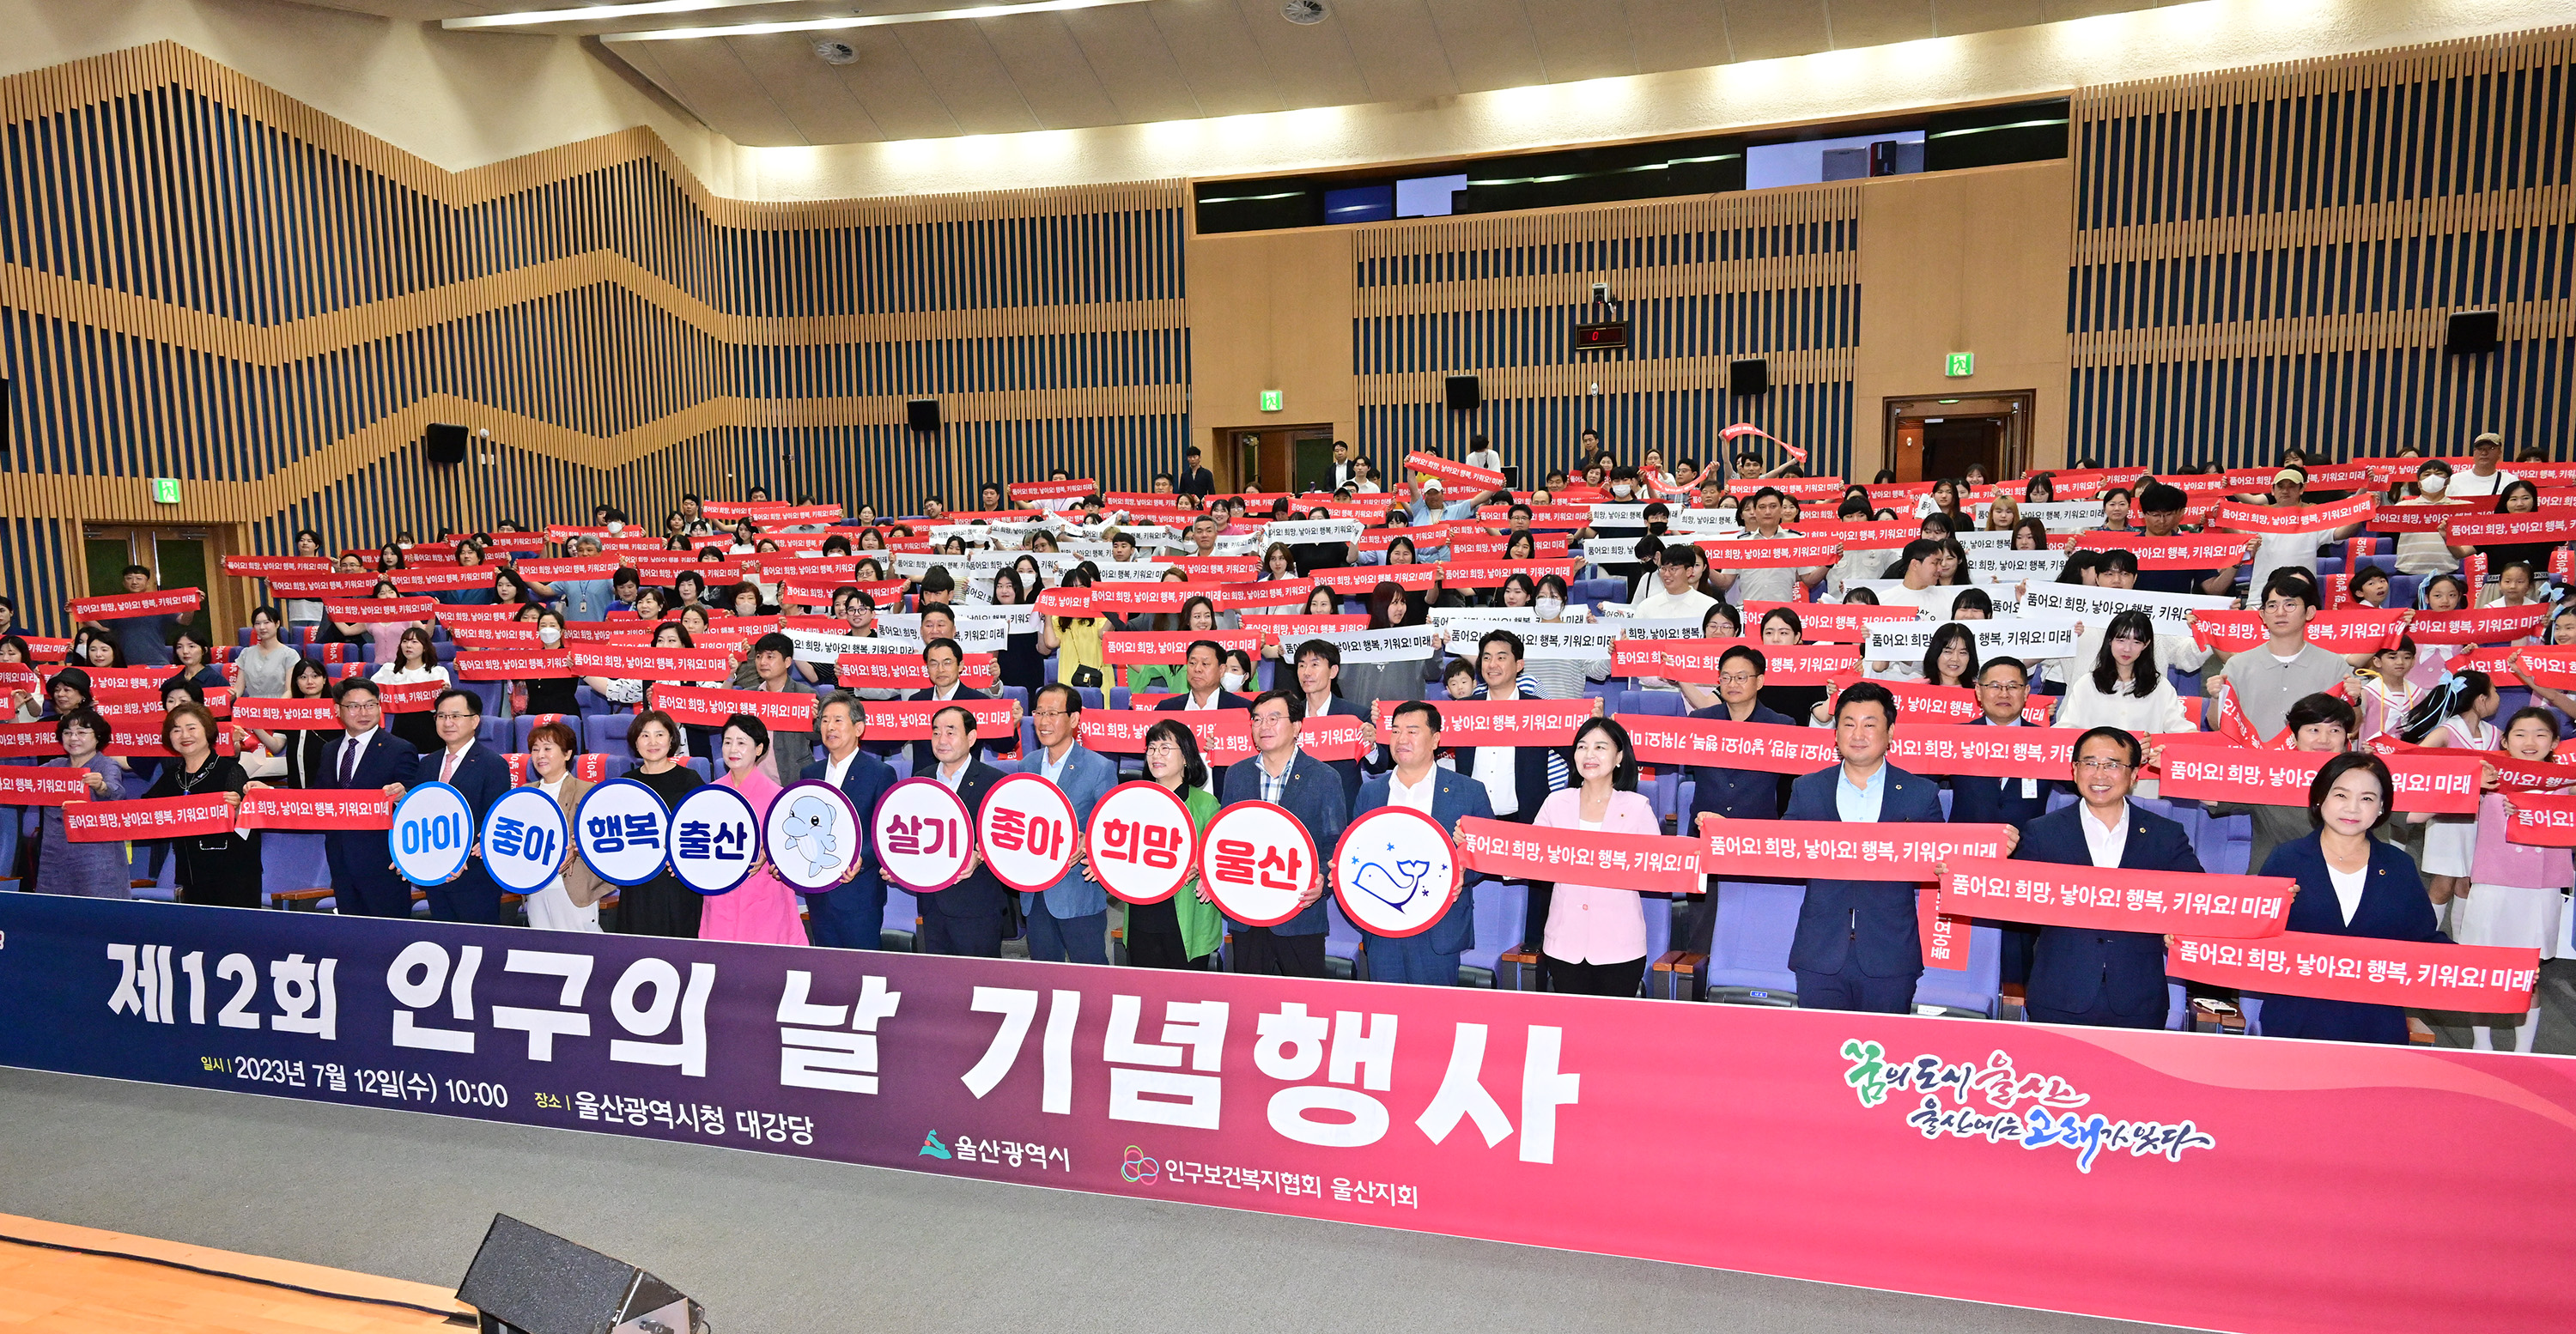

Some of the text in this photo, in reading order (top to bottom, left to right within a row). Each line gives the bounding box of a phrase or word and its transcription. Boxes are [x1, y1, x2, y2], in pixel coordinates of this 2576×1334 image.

[1409, 456, 1428, 465] 품어요!
[1428, 461, 1439, 470] 희망,
[1442, 465, 1460, 475] 낳아요!
[1461, 470, 1471, 478] 행복,
[1473, 473, 1492, 482] 키워요!
[2223, 500, 2370, 525] 품어요! 희망, 낳아요! 행복, 키워요! 미래
[2451, 520, 2567, 536] 품어요! 희망, 낳아요! 행복,
[1446, 567, 1570, 579] 품어요! 희망, 낳아요! 키워요! 미래
[77, 604, 100, 614] 품어요!
[118, 601, 141, 610] 낳아요!
[142, 599, 157, 608] 행복,
[159, 597, 180, 605] 키워요!
[182, 595, 196, 603] 미래
[1091, 591, 1114, 601] 품어요!
[1116, 591, 1131, 603] 희망,
[1134, 592, 1158, 603] 낳아요!
[1161, 592, 1177, 603] 행복,
[1206, 591, 1221, 602] 미래
[2028, 593, 2087, 613] 품어요! 희망,
[1873, 630, 2071, 646] 품어요! 행복, 키워요! 미래
[2409, 619, 2518, 634] 낳아요! 행복, 키워요!
[574, 654, 726, 670] 품어요! 희망, 낳아요! 행복, 키워요! 미래
[659, 695, 809, 719] 품어요! 희망, 낳아요! 행복, 키워요! 미래
[1452, 715, 1561, 731] 낳아요! 행복, 키워요!
[1925, 740, 2045, 762] 희망, 낳아요! 행복,
[2171, 761, 2471, 794] 품어요! 희망, 미래
[69, 804, 228, 828] 품어요! 희망, 낳아요! 행복, 키워요! 미래
[258, 801, 372, 816] 희망, 낳아요! 행복, 키워요!
[2518, 809, 2573, 827] 품어요!
[402, 813, 460, 854] 아이
[492, 816, 555, 865] 좋아
[587, 812, 659, 853] 행복
[679, 821, 747, 860] 출산
[886, 815, 957, 858] 살기
[991, 807, 1064, 860] 좋아
[1101, 819, 1182, 869] 희망
[1710, 836, 1760, 855] 품어요!
[1765, 838, 1800, 858] 희망,
[1805, 840, 1856, 859] 낳아요!
[1862, 841, 1899, 862] 행복,
[1215, 840, 1302, 891] 울산
[1464, 834, 1700, 873] 품어요! 희망, 낳아요! 행복, 키워요! 미
[1953, 874, 2281, 919] 품어요! 희망, 낳아요! 행복, 키워요! 미래
[2180, 941, 2534, 991] 품어요! 희망, 낳아요! 행복, 키워요! 미래
[107, 942, 1581, 1165] 제12회 인구의 날 기념행사
[201, 1057, 507, 1107] 일시 2023년 7월 12일(수) 10:00
[1845, 1042, 2087, 1105] 꿈의 도시 울산
[535, 1092, 813, 1145] 장소 울산광역시청 대강당
[955, 1136, 1069, 1172] 울산광역시
[1166, 1160, 1417, 1209] 인구보건복지협회 울산지회
